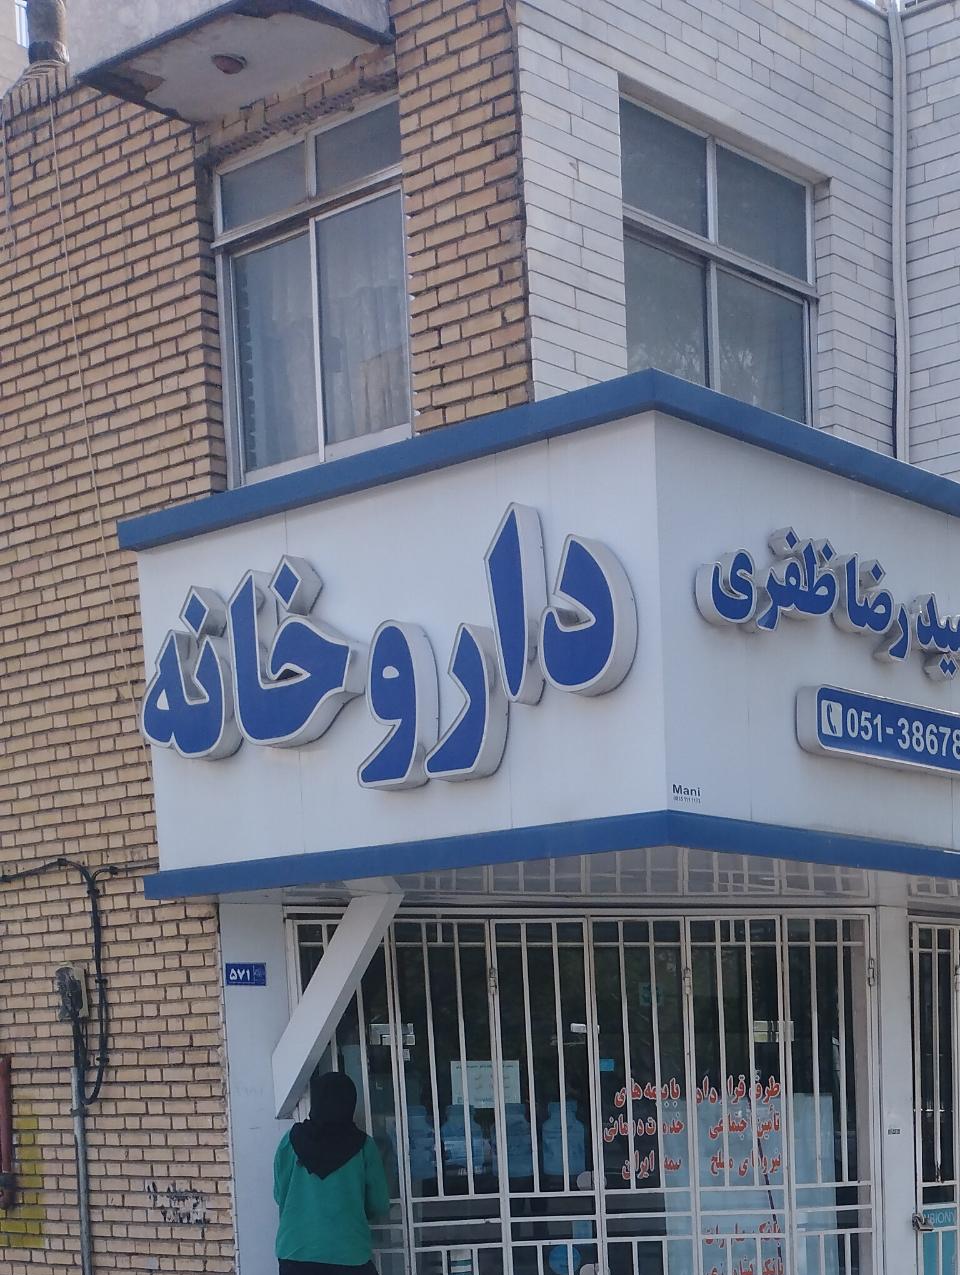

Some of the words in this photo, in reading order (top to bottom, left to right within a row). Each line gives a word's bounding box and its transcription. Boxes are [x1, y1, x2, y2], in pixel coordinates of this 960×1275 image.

[707, 527, 841, 632] ظفری
[141, 502, 626, 789] داروخانه
[672, 783, 701, 796] Mani
[229, 967, 251, 981] ۵۷۱
[694, 1074, 746, 1105] قراداد
[749, 1074, 781, 1105] طرف
[603, 1113, 645, 1143] دمانی
[645, 1111, 684, 1136] خدمت
[708, 1111, 754, 1141] جتمای
